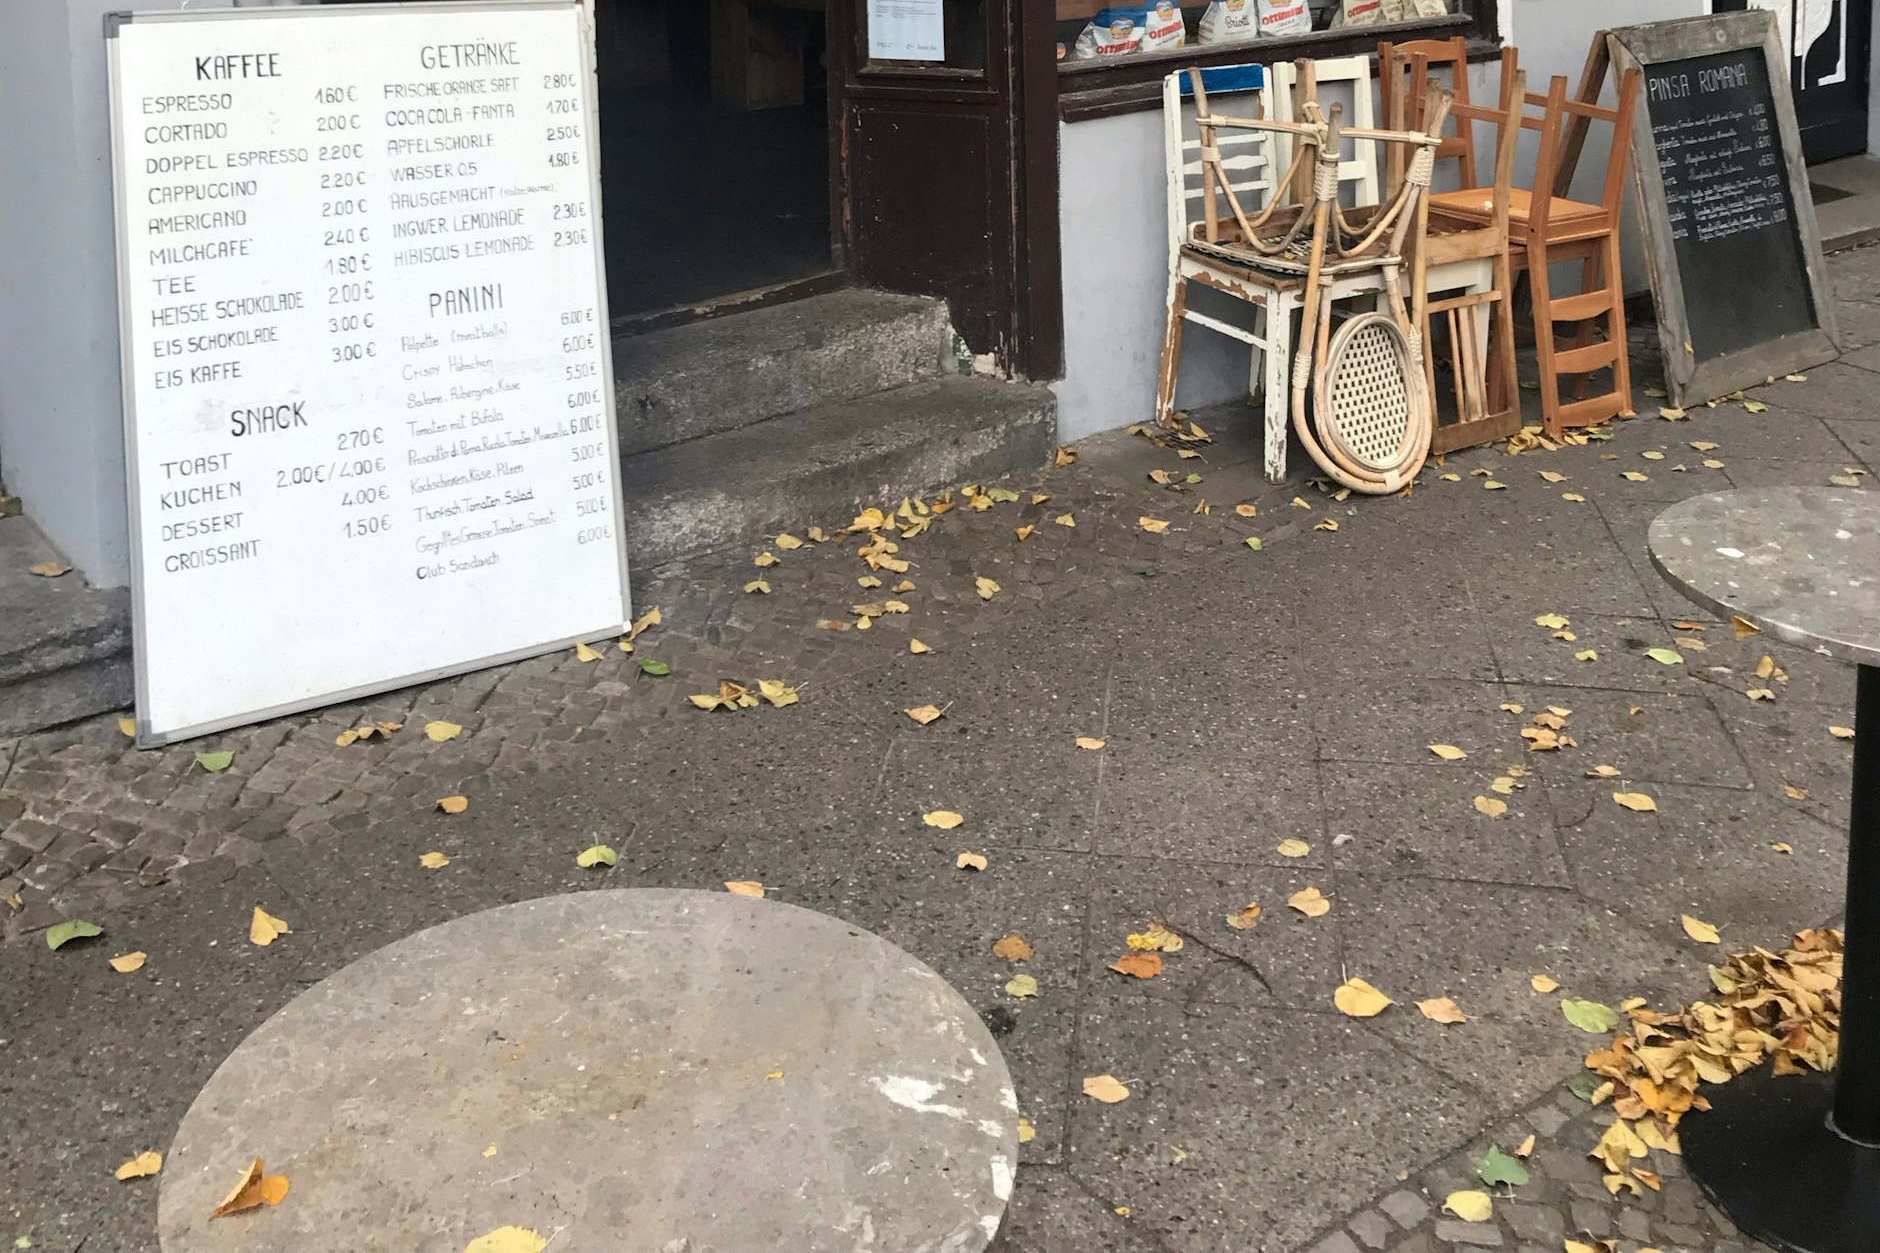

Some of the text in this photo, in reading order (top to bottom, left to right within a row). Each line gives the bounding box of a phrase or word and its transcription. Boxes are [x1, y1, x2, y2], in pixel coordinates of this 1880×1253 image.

[420, 36, 521, 70] GETRÄNKE
[195, 53, 282, 81] KAFFEE
[384, 82, 441, 99] FRISCHE
[443, 79, 487, 95] ORANGE
[490, 77, 520, 93] SAFT
[1650, 63, 1748, 101] PINSA ROMANA
[142, 93, 233, 114] ESPRESSO
[385, 109, 425, 127] COCA
[428, 107, 463, 124] COLA
[144, 122, 228, 144] CORTADO
[388, 133, 496, 156] APFELSCHORLE
[146, 155, 218, 174] DOPPEL
[226, 148, 309, 167] ESPRESSO
[390, 163, 454, 182] WASSER
[148, 180, 258, 205] CAPPUCCINO
[390, 186, 496, 210] HAUSGEMACHT
[149, 210, 247, 235] AMERICANO
[393, 217, 449, 238] INGWER
[453, 208, 525, 232] LEMONADE
[394, 244, 460, 267] HIBISCUS
[465, 234, 535, 258] LEMONADE
[152, 275, 196, 295] TEE
[151, 303, 210, 327] HEISSE
[215, 292, 304, 319] SCHOKOLADE
[429, 283, 503, 318] PANINI
[153, 339, 183, 357] EIS
[188, 326, 279, 352] SCHOKOLADE
[154, 369, 183, 389] EIS
[191, 361, 242, 384] KAFFE
[230, 401, 308, 437] SNACK
[160, 453, 232, 479] TOAST
[161, 481, 242, 510] KUCHEN
[162, 512, 244, 542] DESSERT
[165, 539, 261, 572] CROISSANT
[416, 562, 446, 580] Club
